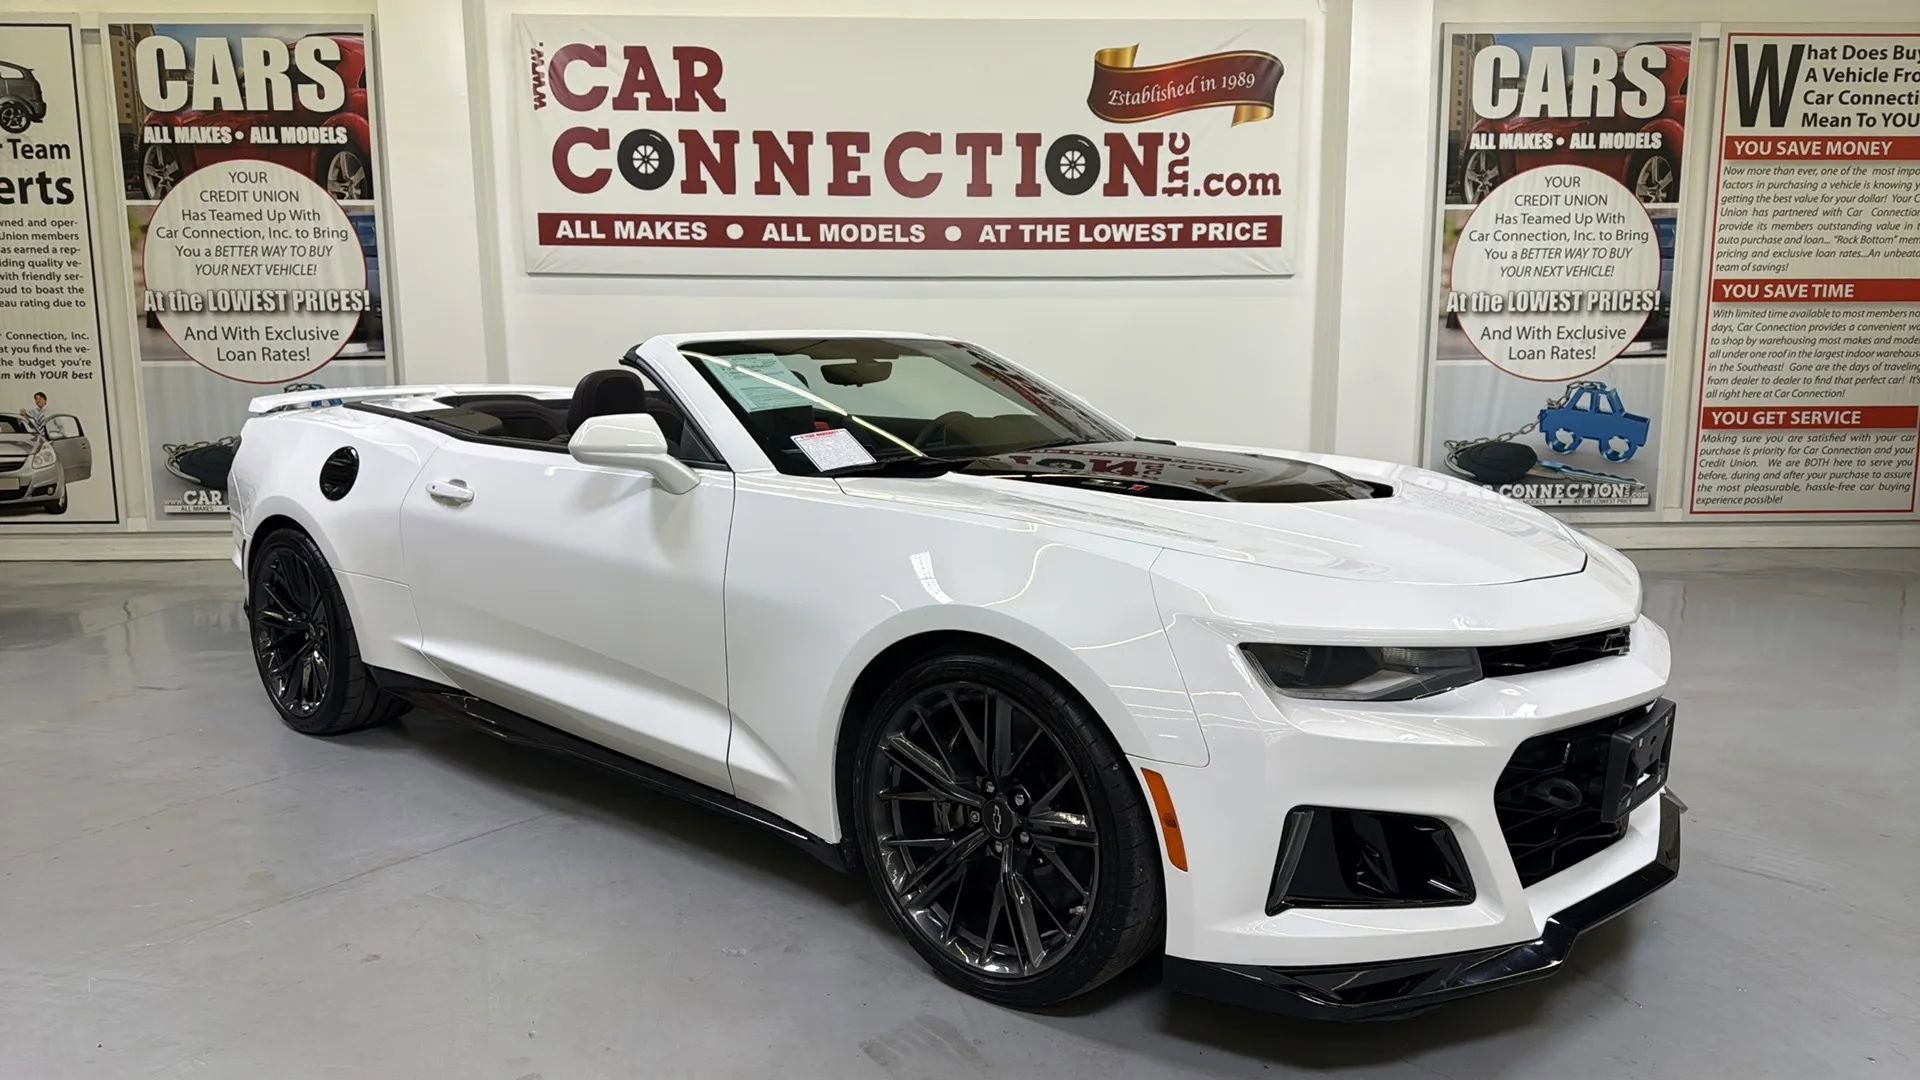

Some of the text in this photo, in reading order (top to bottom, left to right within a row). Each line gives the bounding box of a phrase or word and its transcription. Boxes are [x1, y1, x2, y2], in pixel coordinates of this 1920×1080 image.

[1842, 45, 1887, 60] Does
[136, 35, 346, 113] CARS
[549, 43, 726, 112] CAR
[1805, 68, 1818, 82] A
[1822, 68, 1888, 83] Vehicle
[1108, 72, 1256, 105] Established in 1989
[1473, 45, 1667, 119] CARS
[1803, 90, 1833, 105] Car
[1802, 112, 1920, 127] Mean To YOU
[143, 126, 347, 144] ALL MAKES ALL MODELS
[1470, 133, 1662, 150] ALL MAKES ALL MODELS
[8, 139, 71, 159] Team
[1735, 141, 1892, 155] YOU SAVE MONEY
[552, 126, 1164, 199] CONNECTION
[1193, 172, 1281, 196] .com
[228, 171, 268, 184] YOUR
[1544, 176, 1581, 188] YOUR
[200, 190, 299, 203] CREDIT UNION
[1515, 195, 1608, 206] CREDIT UNION
[27, 219, 47, 227] and
[182, 209, 321, 225] Has Teamed Up With
[1495, 213, 1625, 228] Has Teamed Up With
[31, 232, 79, 241] members
[156, 227, 348, 242] Car Connection, Inc. to Bring
[556, 220, 1268, 243] ALL MAKES ALL MODELS AT THE LOWEST PRICE
[1469, 230, 1490, 241] Car
[1494, 230, 1571, 244] Connection,
[1599, 231, 1612, 241] to
[1616, 230, 1649, 244] Bring
[176, 246, 333, 257] You a BETTER WAY TO BUY
[1485, 248, 1509, 259] You
[1520, 248, 1562, 259] BETTER
[1565, 248, 1590, 259] WAY
[1593, 248, 1607, 259] TO
[1609, 248, 1633, 259] BUY
[28, 259, 63, 270] quality
[195, 264, 229, 275] YOUR
[231, 264, 262, 275] NEXT
[1500, 266, 1532, 277] YOUR
[1534, 266, 1564, 277] NEXT
[1723, 284, 1854, 297] YOU SAVE TIME
[20, 299, 86, 310] rating due to
[144, 289, 370, 312] At the LOWEST PRICES!
[1446, 290, 1660, 313] At the LOWEST PRICES!
[184, 326, 339, 340] And With Exclusive
[1480, 326, 1626, 340] And With Exclusive
[216, 347, 310, 361] Loan Rates!
[1508, 346, 1596, 360] Loan Rates!
[19, 358, 91, 369] budget you're
[14, 371, 93, 379] with YOUR best
[1706, 390, 1717, 398] all
[1719, 390, 1740, 400] right
[1742, 390, 1760, 398] here
[1774, 390, 1790, 398] Car
[1712, 411, 1861, 424] YOU GET SERVICE
[1701, 434, 1737, 444] Making
[1766, 436, 1783, 444] you
[1808, 434, 1845, 442] satisfied
[1851, 433, 1870, 442] with
[1875, 434, 1897, 443] your
[1699, 459, 1725, 468] Credit
[1769, 459, 1782, 467] We
[1804, 459, 1830, 467] BOTH
[1833, 458, 1852, 466] here
[1897, 459, 1913, 468] you
[184, 490, 222, 505] CAR
[1499, 483, 1625, 499] CONNECTION
